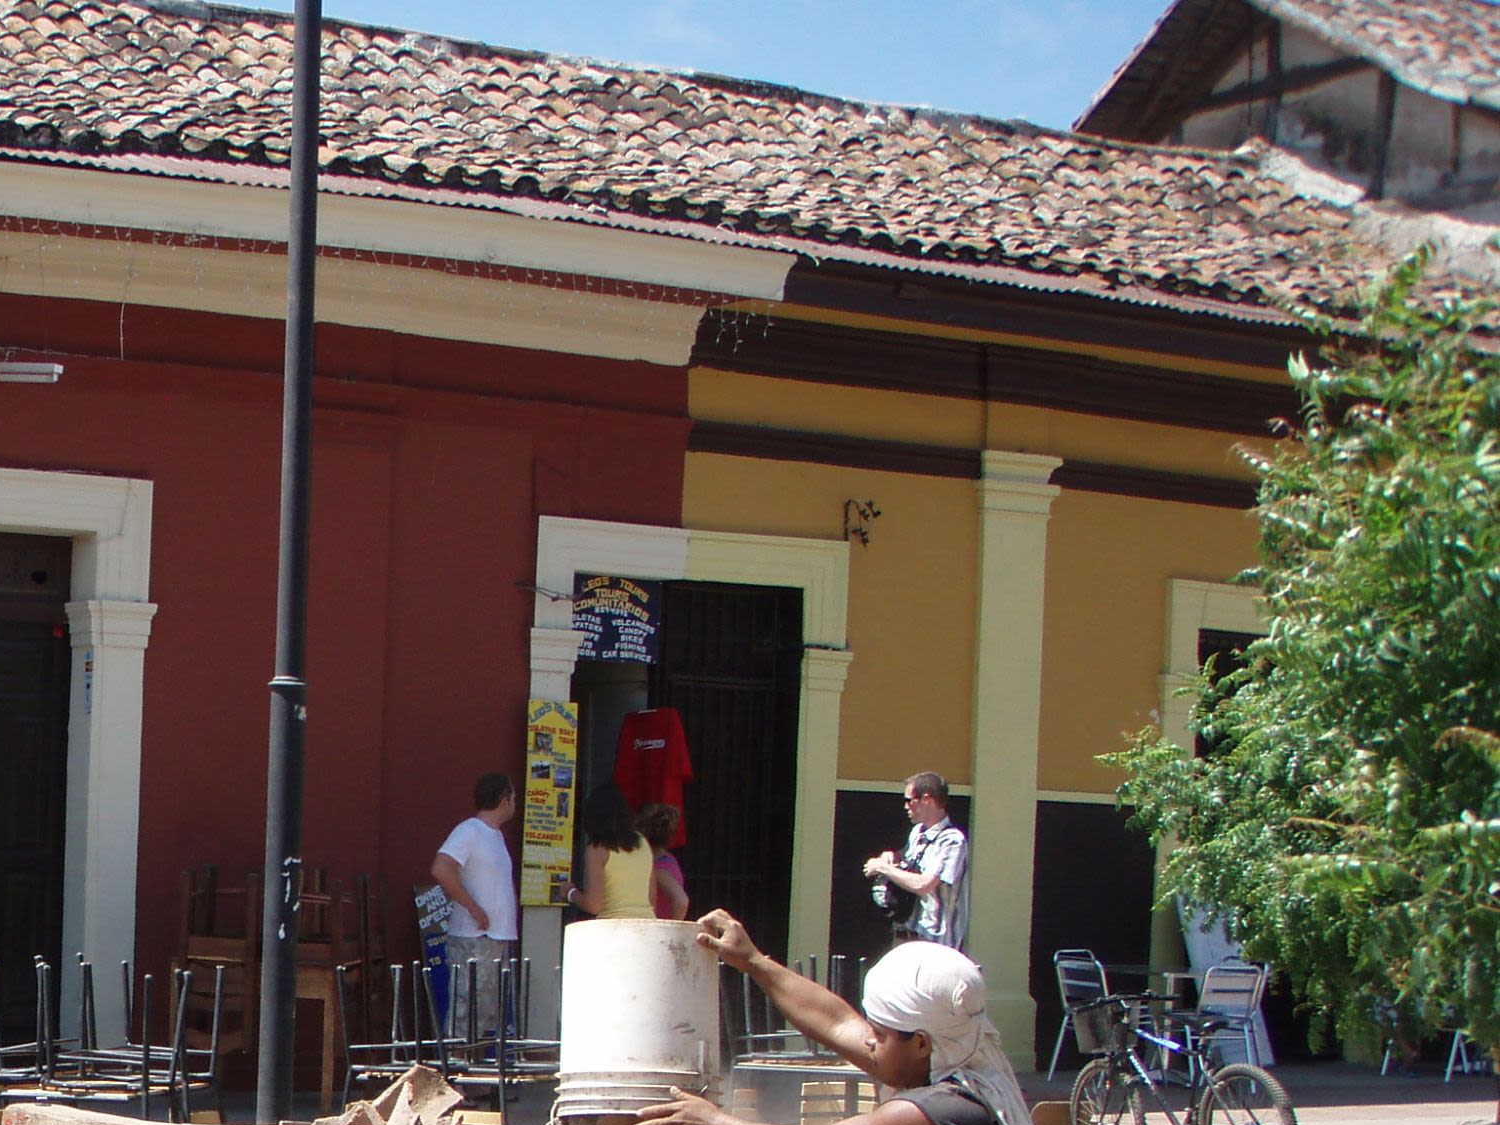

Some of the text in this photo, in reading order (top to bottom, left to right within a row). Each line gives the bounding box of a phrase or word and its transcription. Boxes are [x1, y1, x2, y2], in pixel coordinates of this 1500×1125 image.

[594, 588, 630, 602] TOURS
[620, 579, 650, 604] TOURS
[573, 598, 650, 622] COMUNITARIOS
[415, 885, 445, 908] OWNE
[426, 895, 447, 913] AND
[418, 903, 453, 929] OPERA
